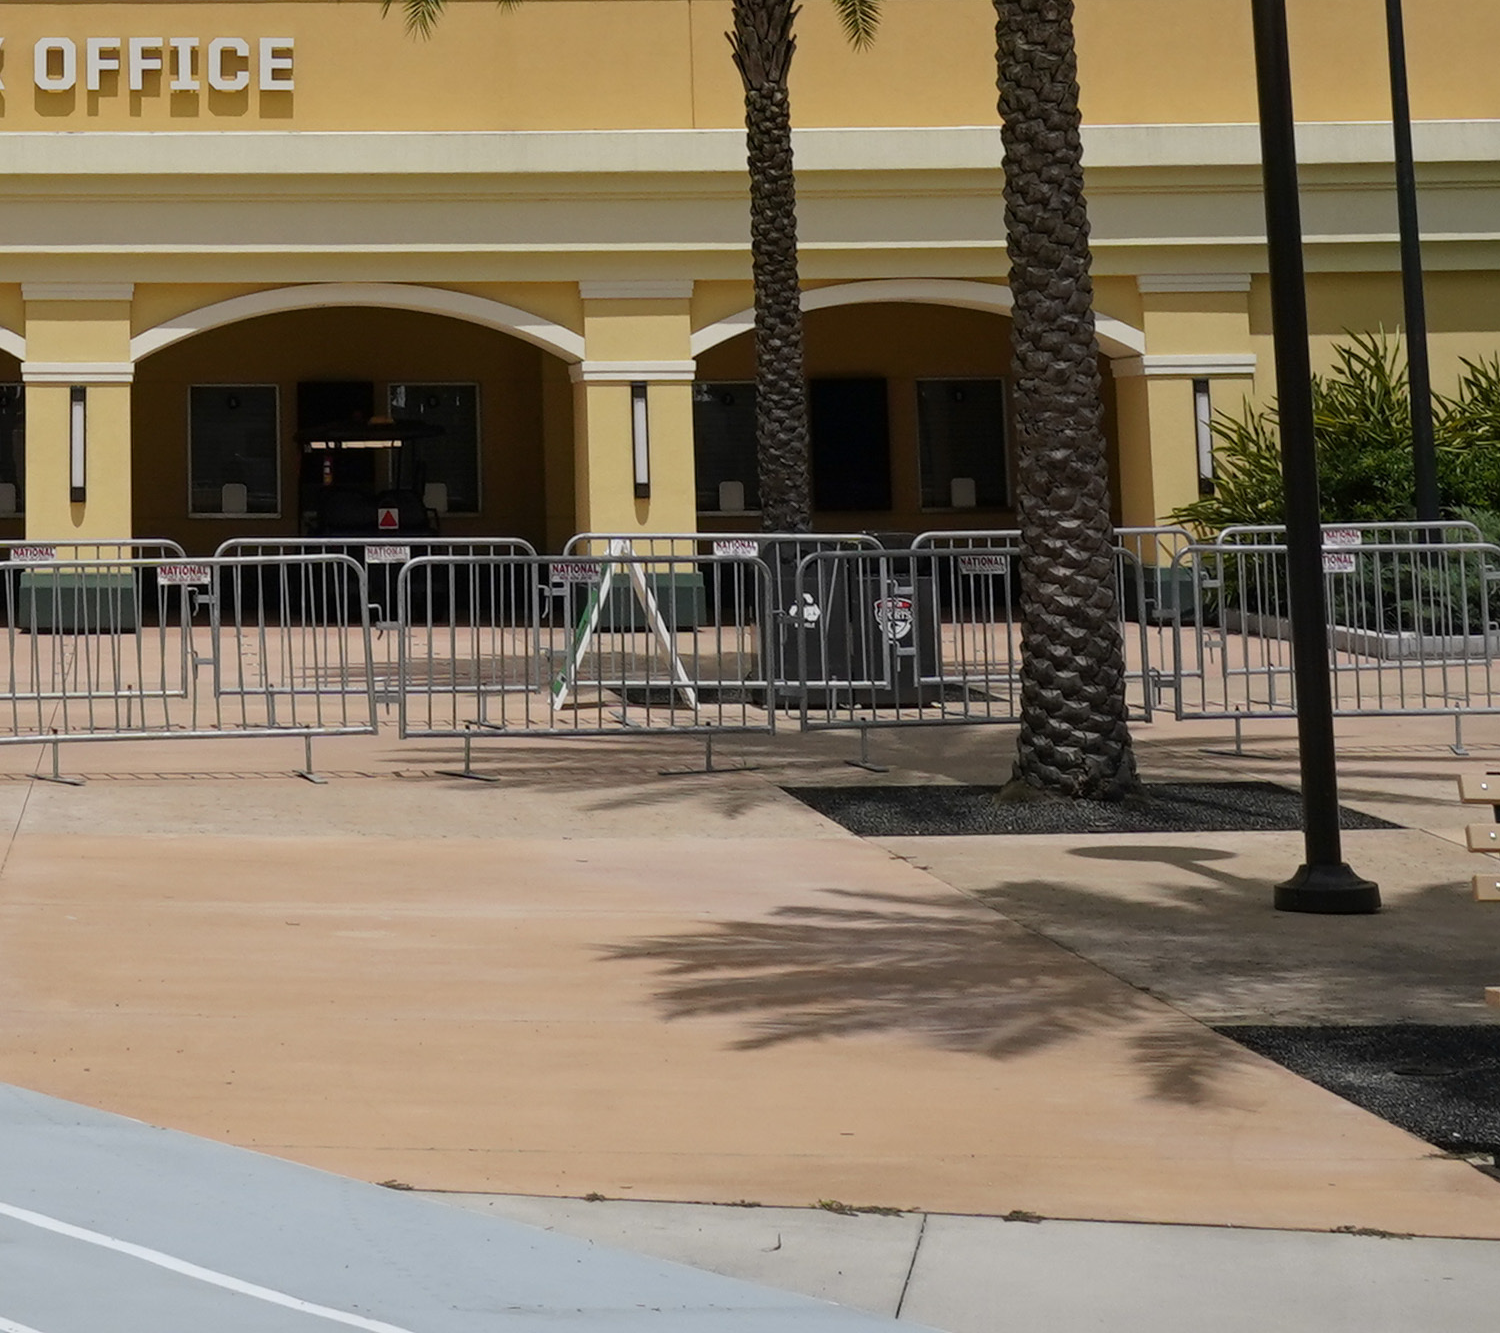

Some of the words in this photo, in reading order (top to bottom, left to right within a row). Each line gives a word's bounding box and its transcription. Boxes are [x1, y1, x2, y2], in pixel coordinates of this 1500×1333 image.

[34, 37, 294, 90] OFFICE
[716, 540, 756, 549] NATIONAL
[13, 547, 55, 558] NATIONAL
[367, 546, 409, 557] NATIONAL
[961, 557, 1004, 566] NATIONAL
[1322, 554, 1353, 564] TIONAL
[159, 565, 209, 576] NATIONAL
[552, 564, 599, 574] NATIONAL
